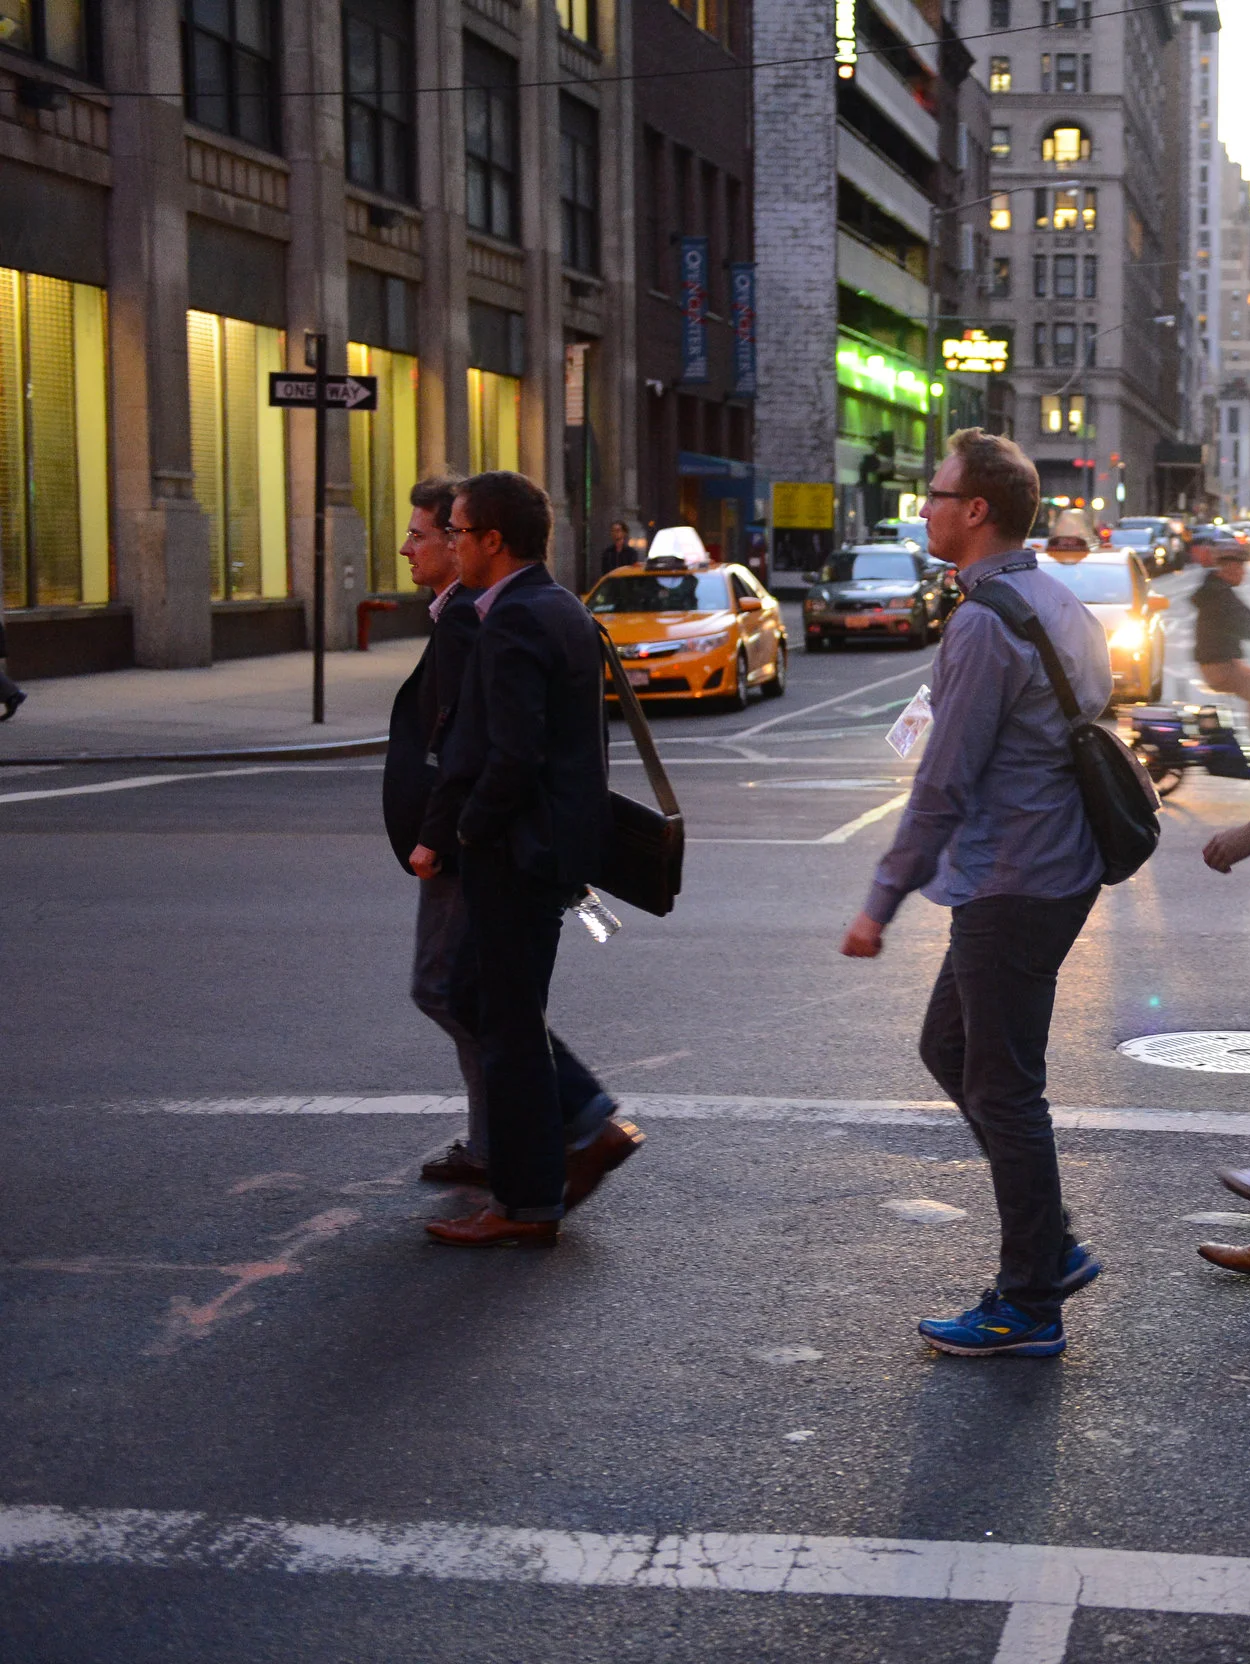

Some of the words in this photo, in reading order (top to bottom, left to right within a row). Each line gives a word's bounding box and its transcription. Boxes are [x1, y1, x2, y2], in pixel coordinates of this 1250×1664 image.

[942, 338, 1008, 360] PARK
[283, 383, 315, 397] ONE
[328, 386, 360, 399] WAY
